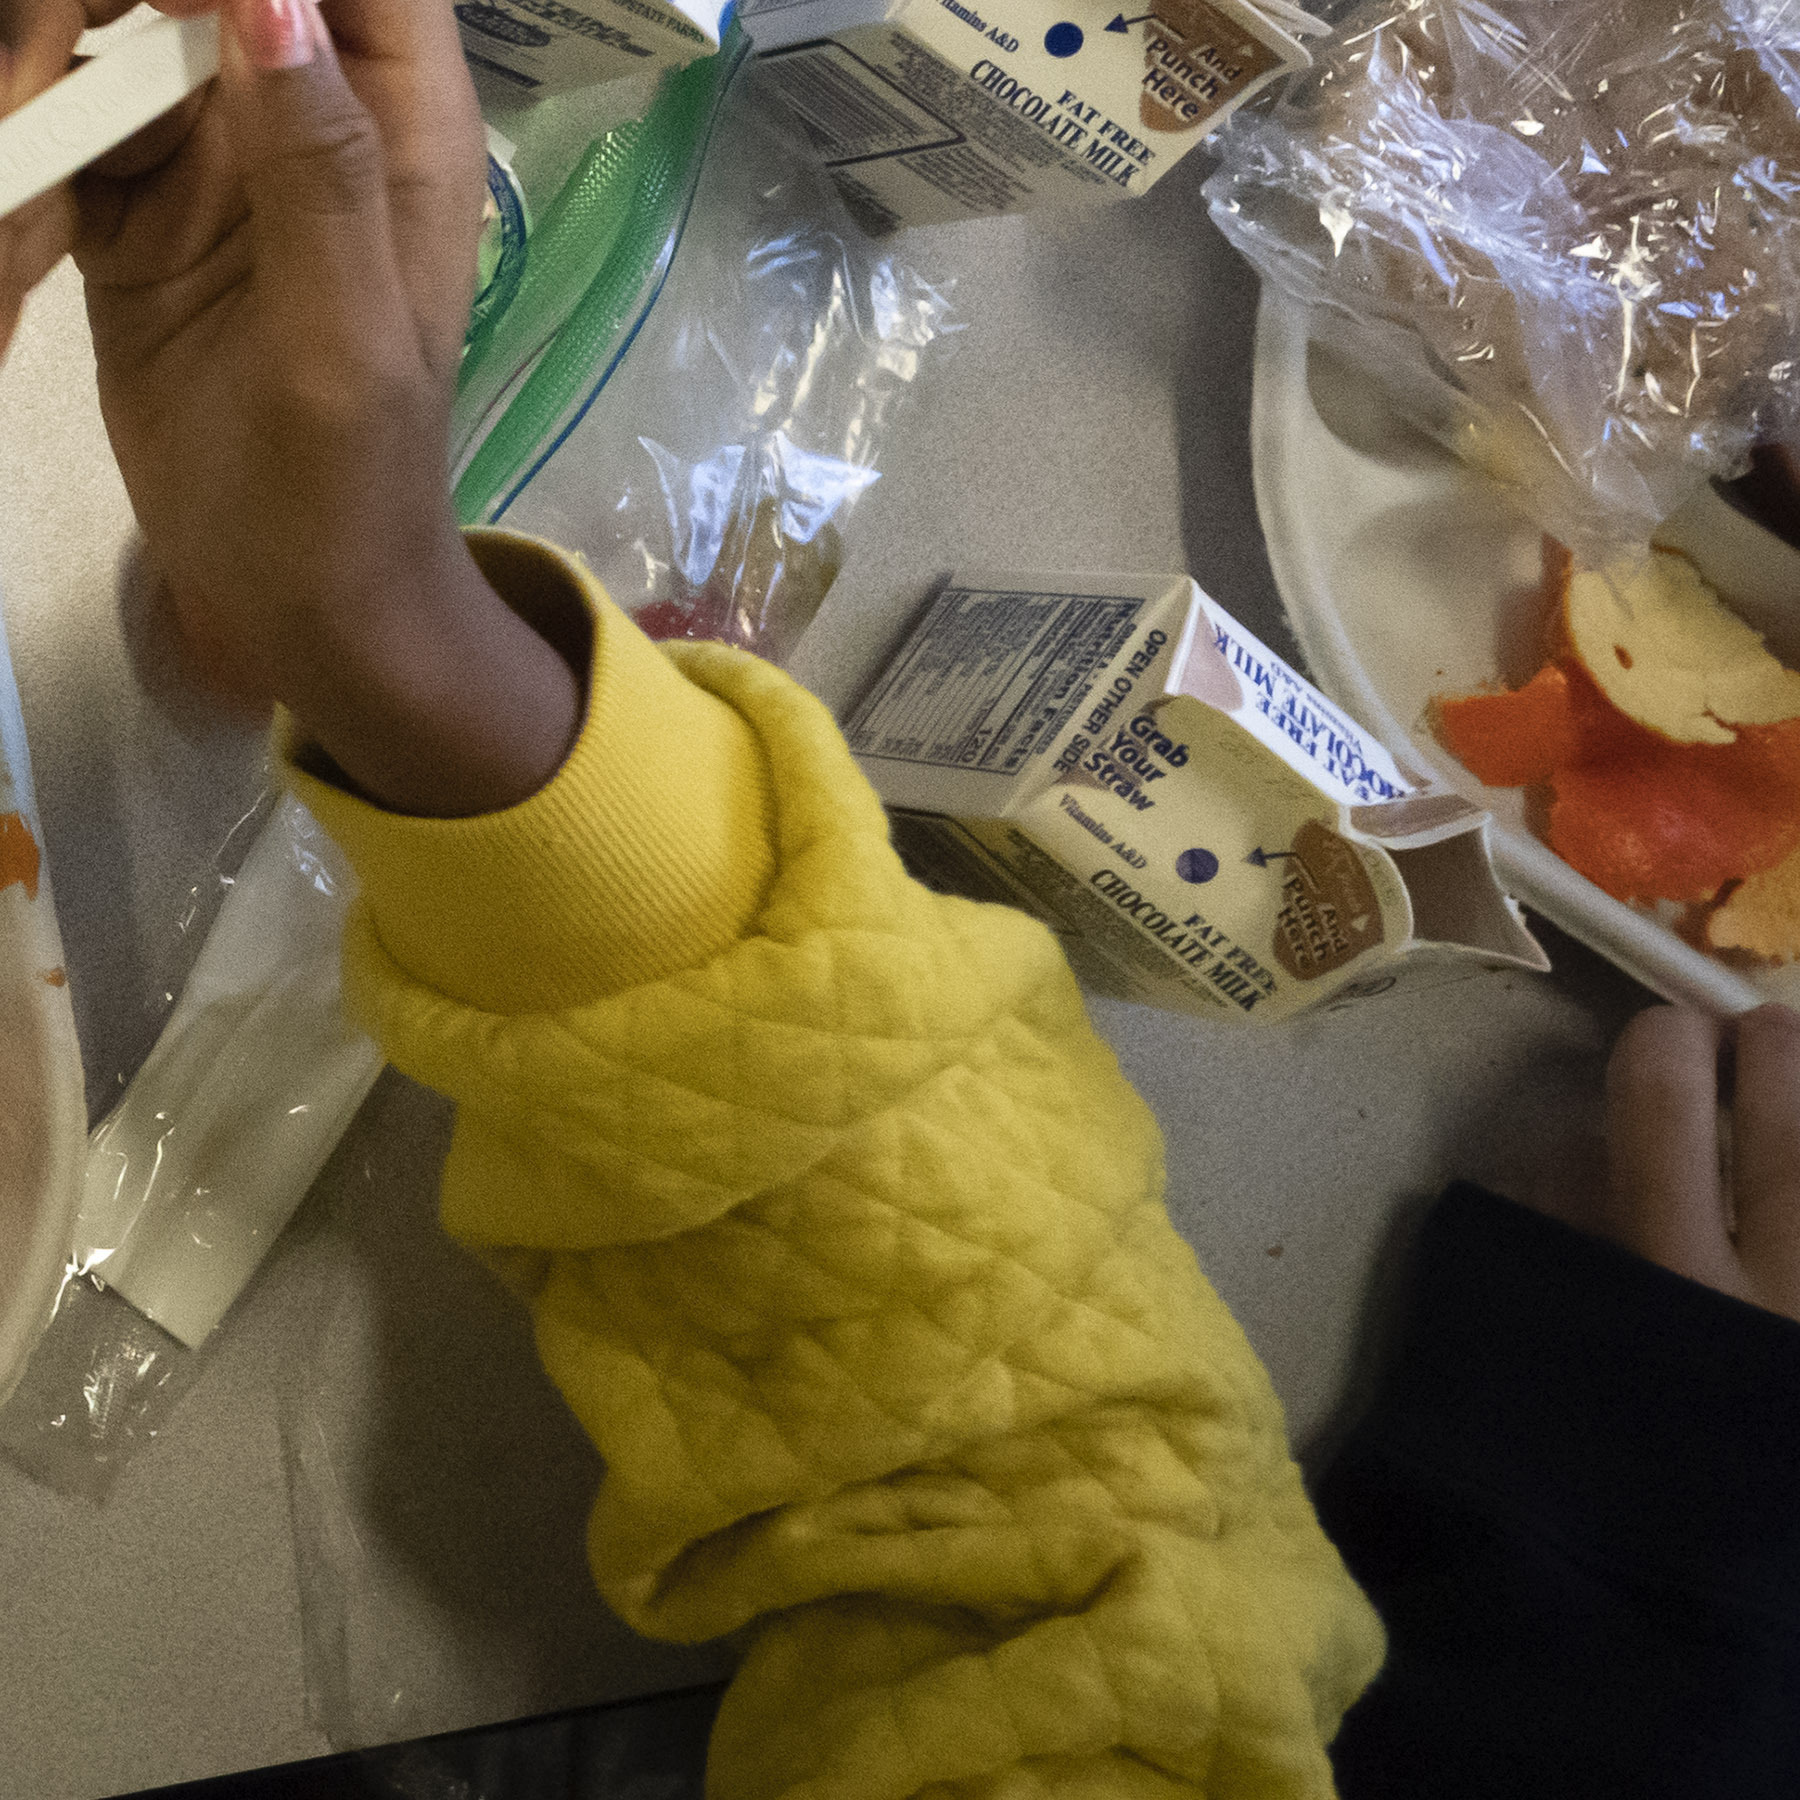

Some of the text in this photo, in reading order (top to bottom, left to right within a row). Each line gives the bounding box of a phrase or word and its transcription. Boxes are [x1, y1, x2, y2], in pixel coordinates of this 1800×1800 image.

[985, 26, 1019, 53] A&D
[1196, 47, 1242, 81] And
[1142, 68, 1200, 120] Here
[1147, 37, 1219, 101] Punch
[969, 59, 1088, 151] CHOCOLATE
[1081, 138, 1140, 187] MILK
[1056, 89, 1156, 166] FAT FREE
[1050, 601, 1138, 700] Nutrition
[1125, 629, 1167, 680] OPEN
[1214, 623, 1277, 698] MILK
[1082, 676, 1133, 735] OTHER
[1255, 691, 1317, 760] FREE
[960, 728, 994, 763] 120
[1001, 706, 1060, 770] Facts
[1052, 733, 1091, 773] SIDE
[1109, 729, 1167, 783] Your
[1129, 715, 1190, 768] Grab
[1083, 752, 1156, 812] Straw
[1058, 793, 1114, 845] Vitamins
[1089, 868, 1217, 969] CHOCOLATE
[1202, 961, 1267, 1013] MILK
[1183, 913, 1230, 948] FAT
[1283, 876, 1327, 962] Punch
[1323, 906, 1349, 953] And
